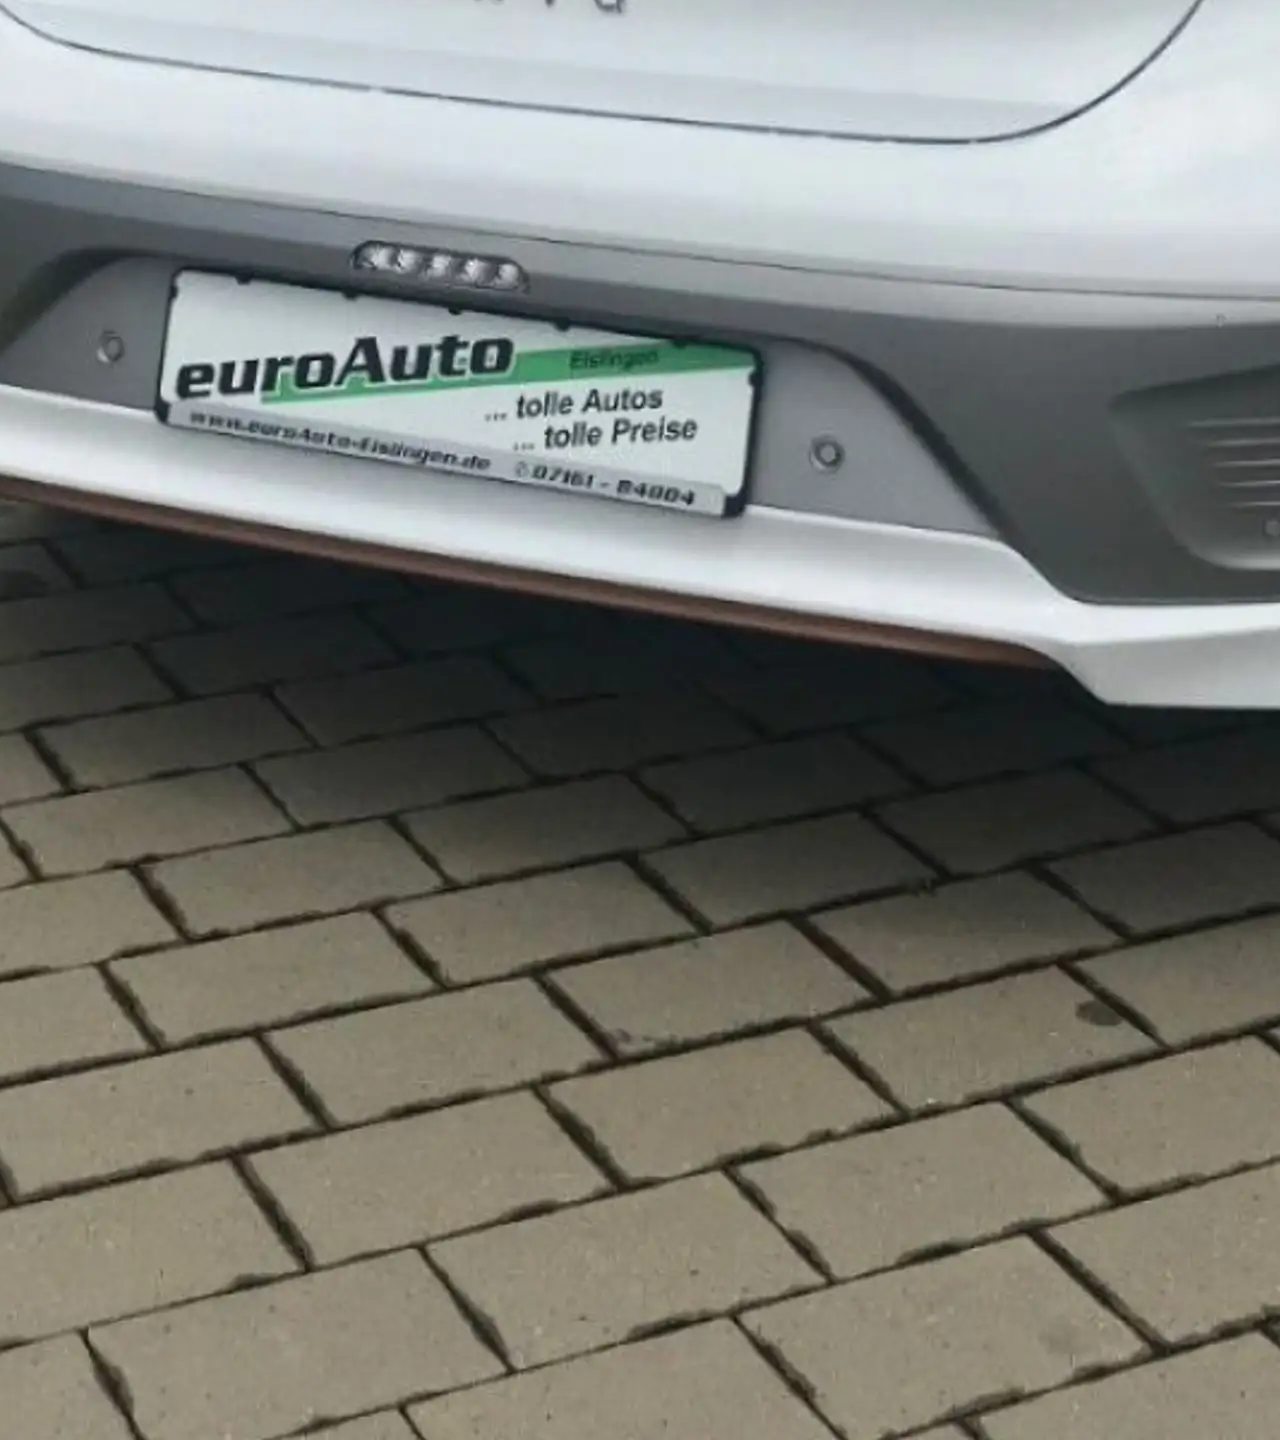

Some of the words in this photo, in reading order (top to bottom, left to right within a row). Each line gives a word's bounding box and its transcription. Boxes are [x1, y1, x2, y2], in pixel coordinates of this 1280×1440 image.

[175, 334, 515, 400] euroAuto
[516, 389, 575, 419] tolle
[581, 388, 665, 413] Autos
[543, 423, 604, 450] tolle
[610, 415, 699, 445] Preise
